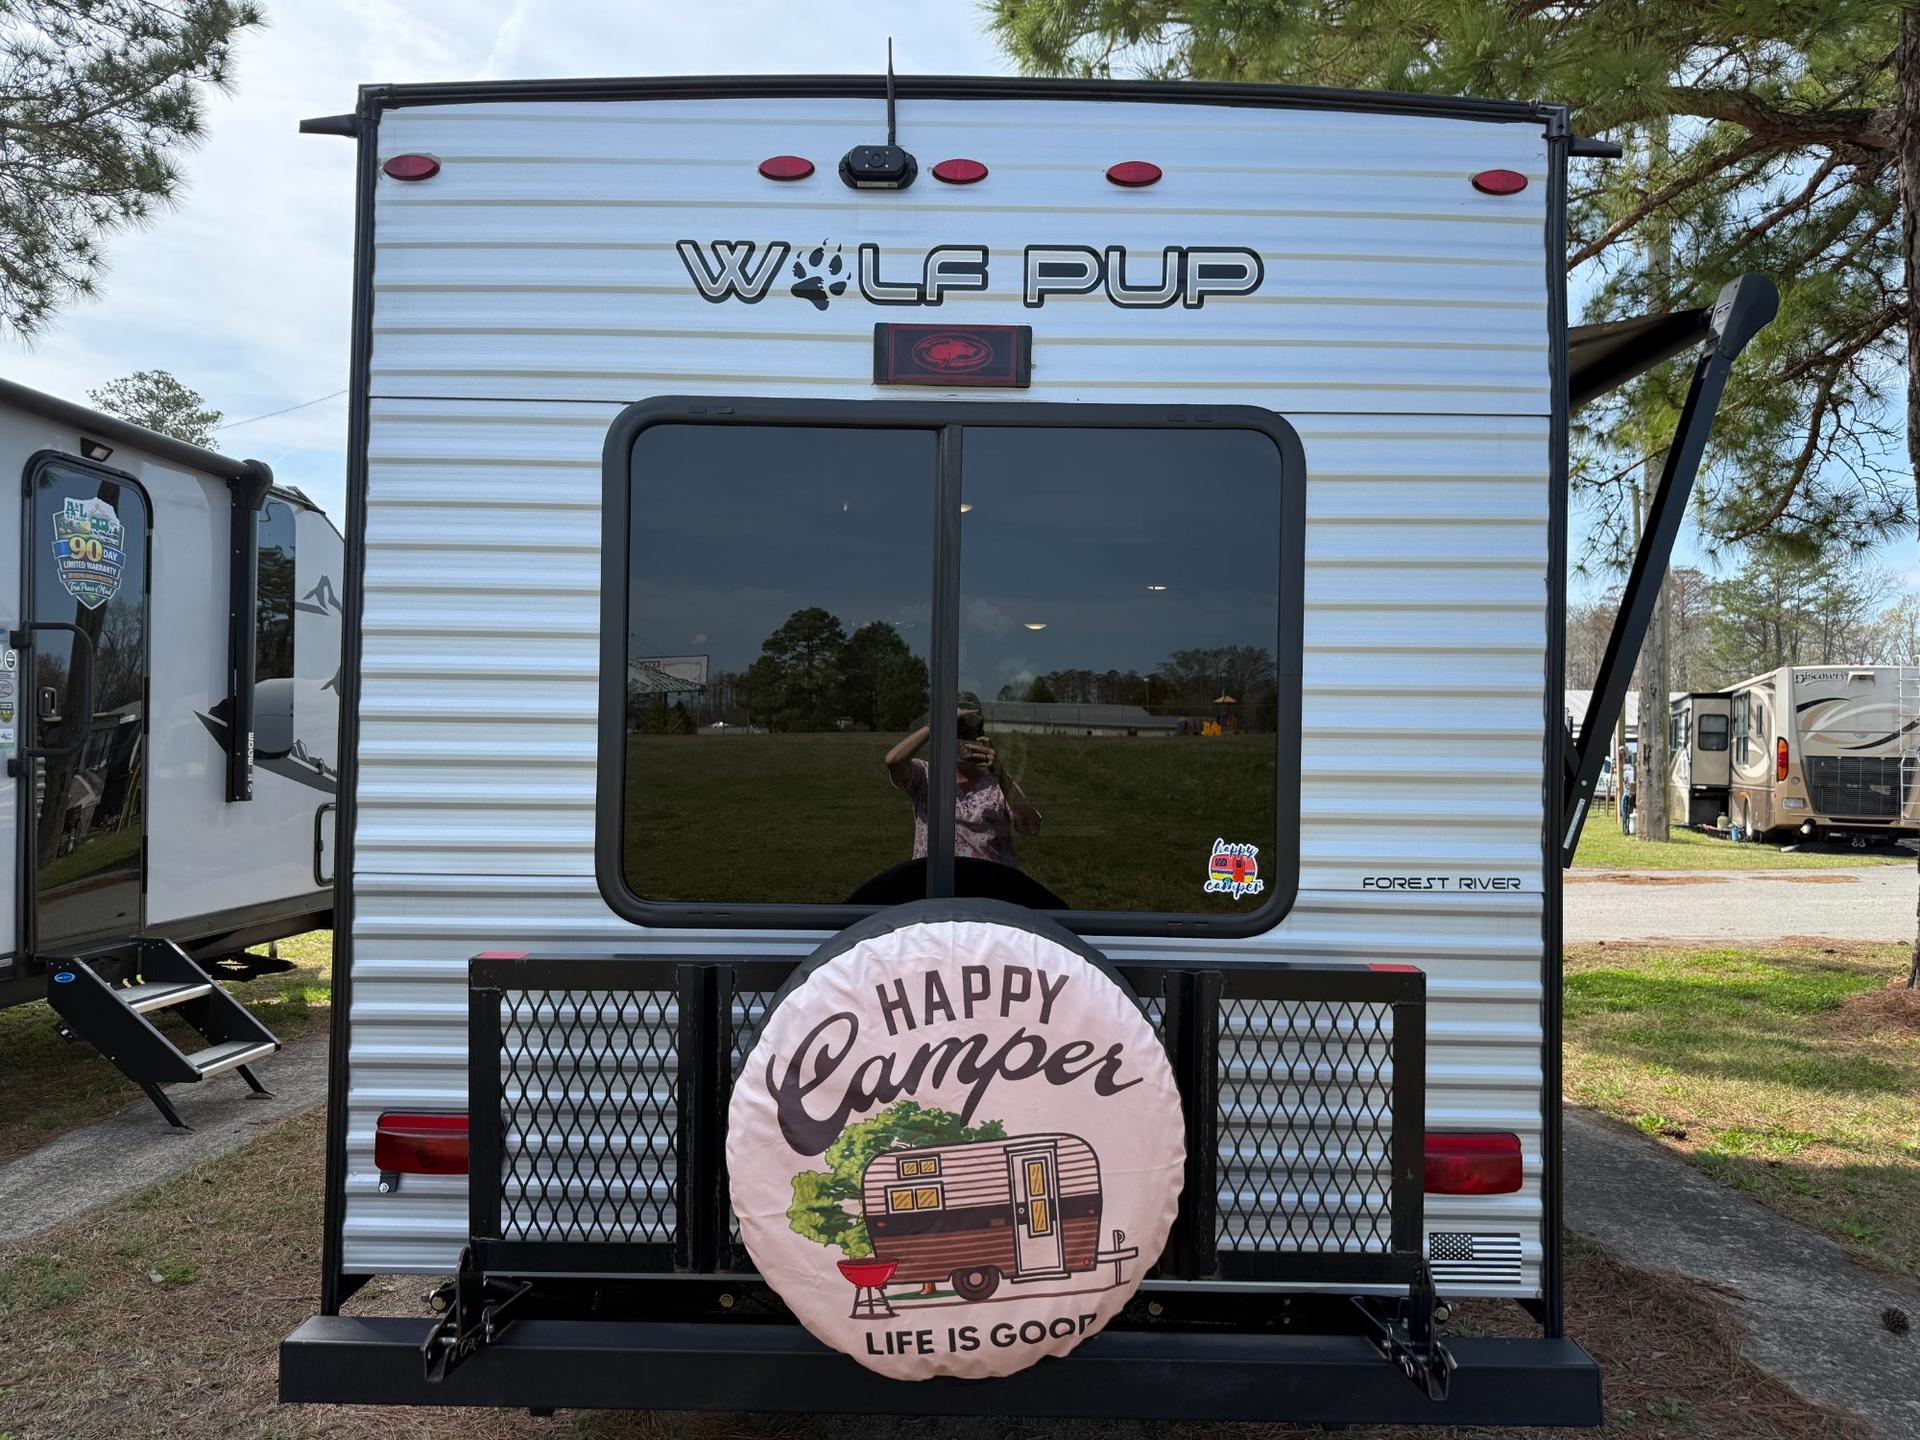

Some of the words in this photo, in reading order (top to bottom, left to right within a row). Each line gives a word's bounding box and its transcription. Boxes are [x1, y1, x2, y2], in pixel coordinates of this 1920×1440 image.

[1023, 244, 1265, 310] PUP
[69, 536, 102, 562] 90
[103, 549, 118, 561] DAY
[64, 561, 86, 569] LIMITED
[86, 562, 117, 576] WARRANTY
[1795, 672, 1846, 684] Discovery
[1213, 838, 1259, 859] happy
[1205, 881, 1263, 899] camper
[1362, 877, 1449, 890] FOREST
[1459, 877, 1521, 890] RIVER
[875, 965, 1070, 1037] HAPPY
[766, 1011, 1144, 1157] Camper
[865, 1328, 935, 1355] LIFE
[948, 1326, 981, 1352] IS
